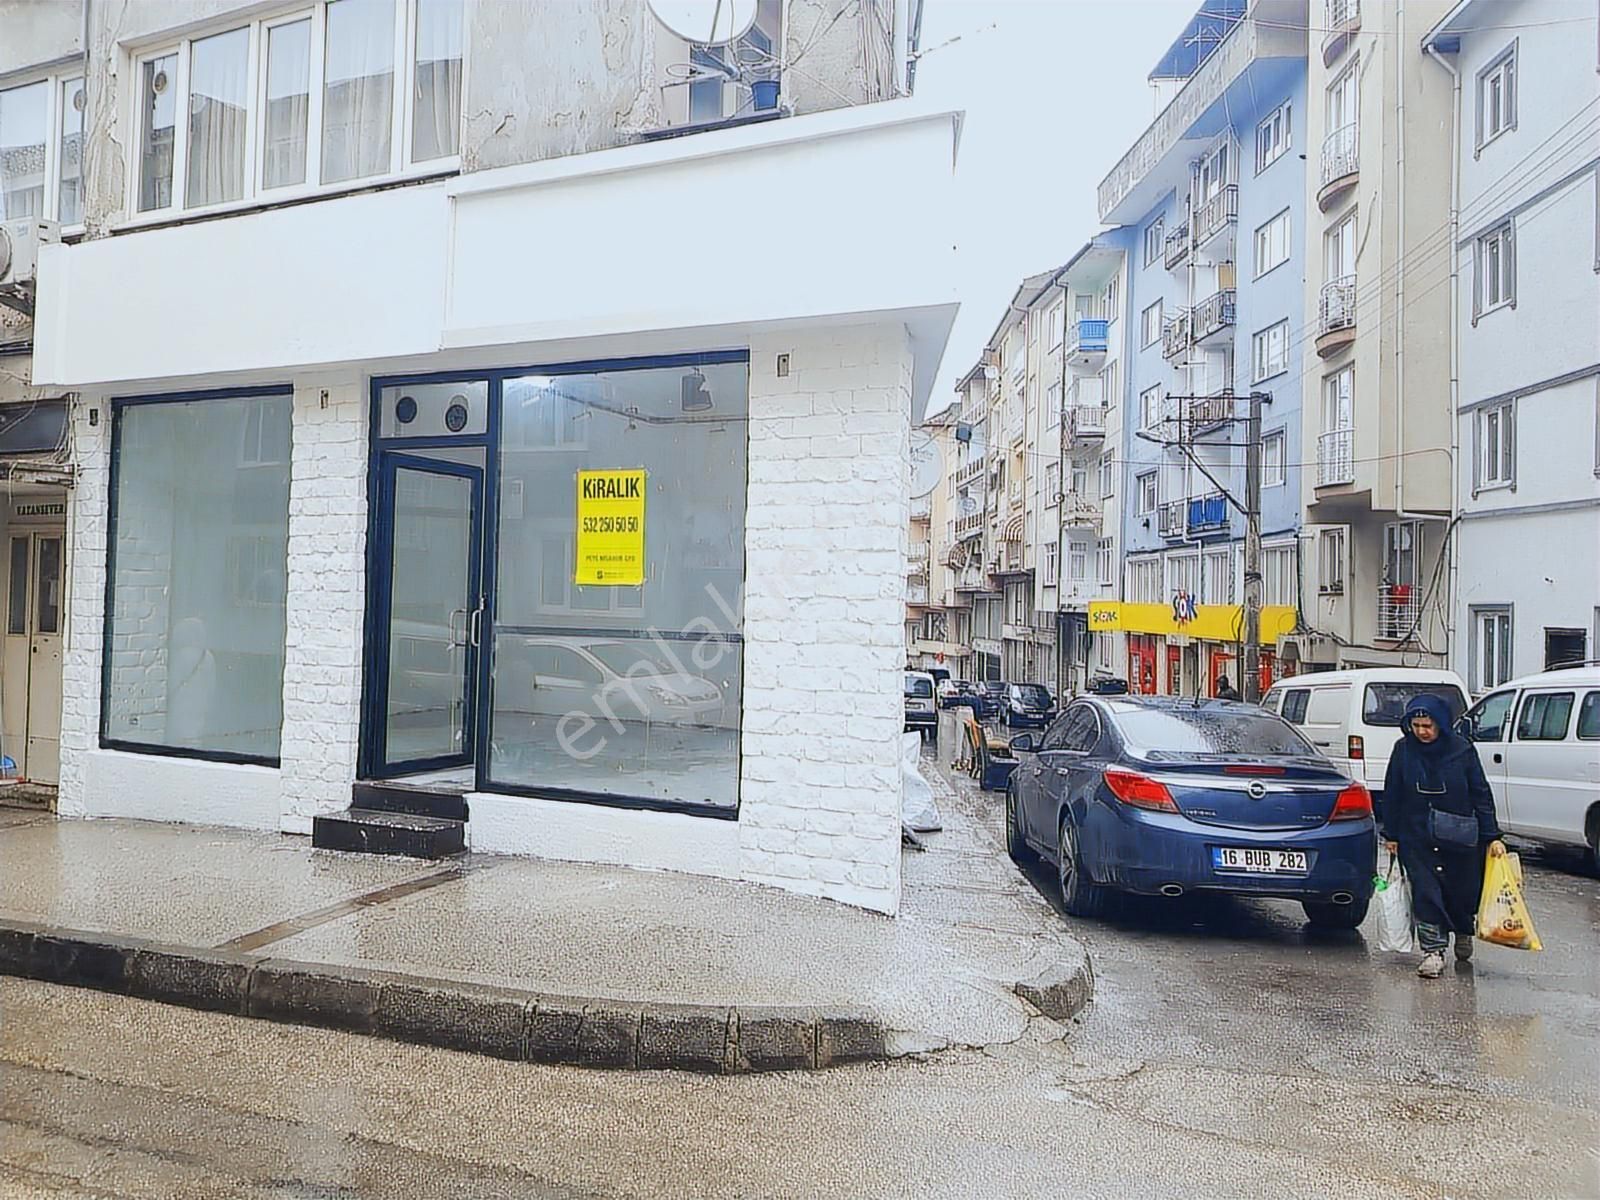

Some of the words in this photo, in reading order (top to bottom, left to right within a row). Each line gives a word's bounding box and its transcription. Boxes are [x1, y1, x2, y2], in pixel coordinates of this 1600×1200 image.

[583, 516, 598, 533] 532
[599, 516, 614, 533] 250
[616, 516, 626, 533] 50
[628, 516, 639, 533] 50
[1222, 849, 1238, 866] 16
[1244, 850, 1272, 867] BUB
[1278, 852, 1305, 870] 282
